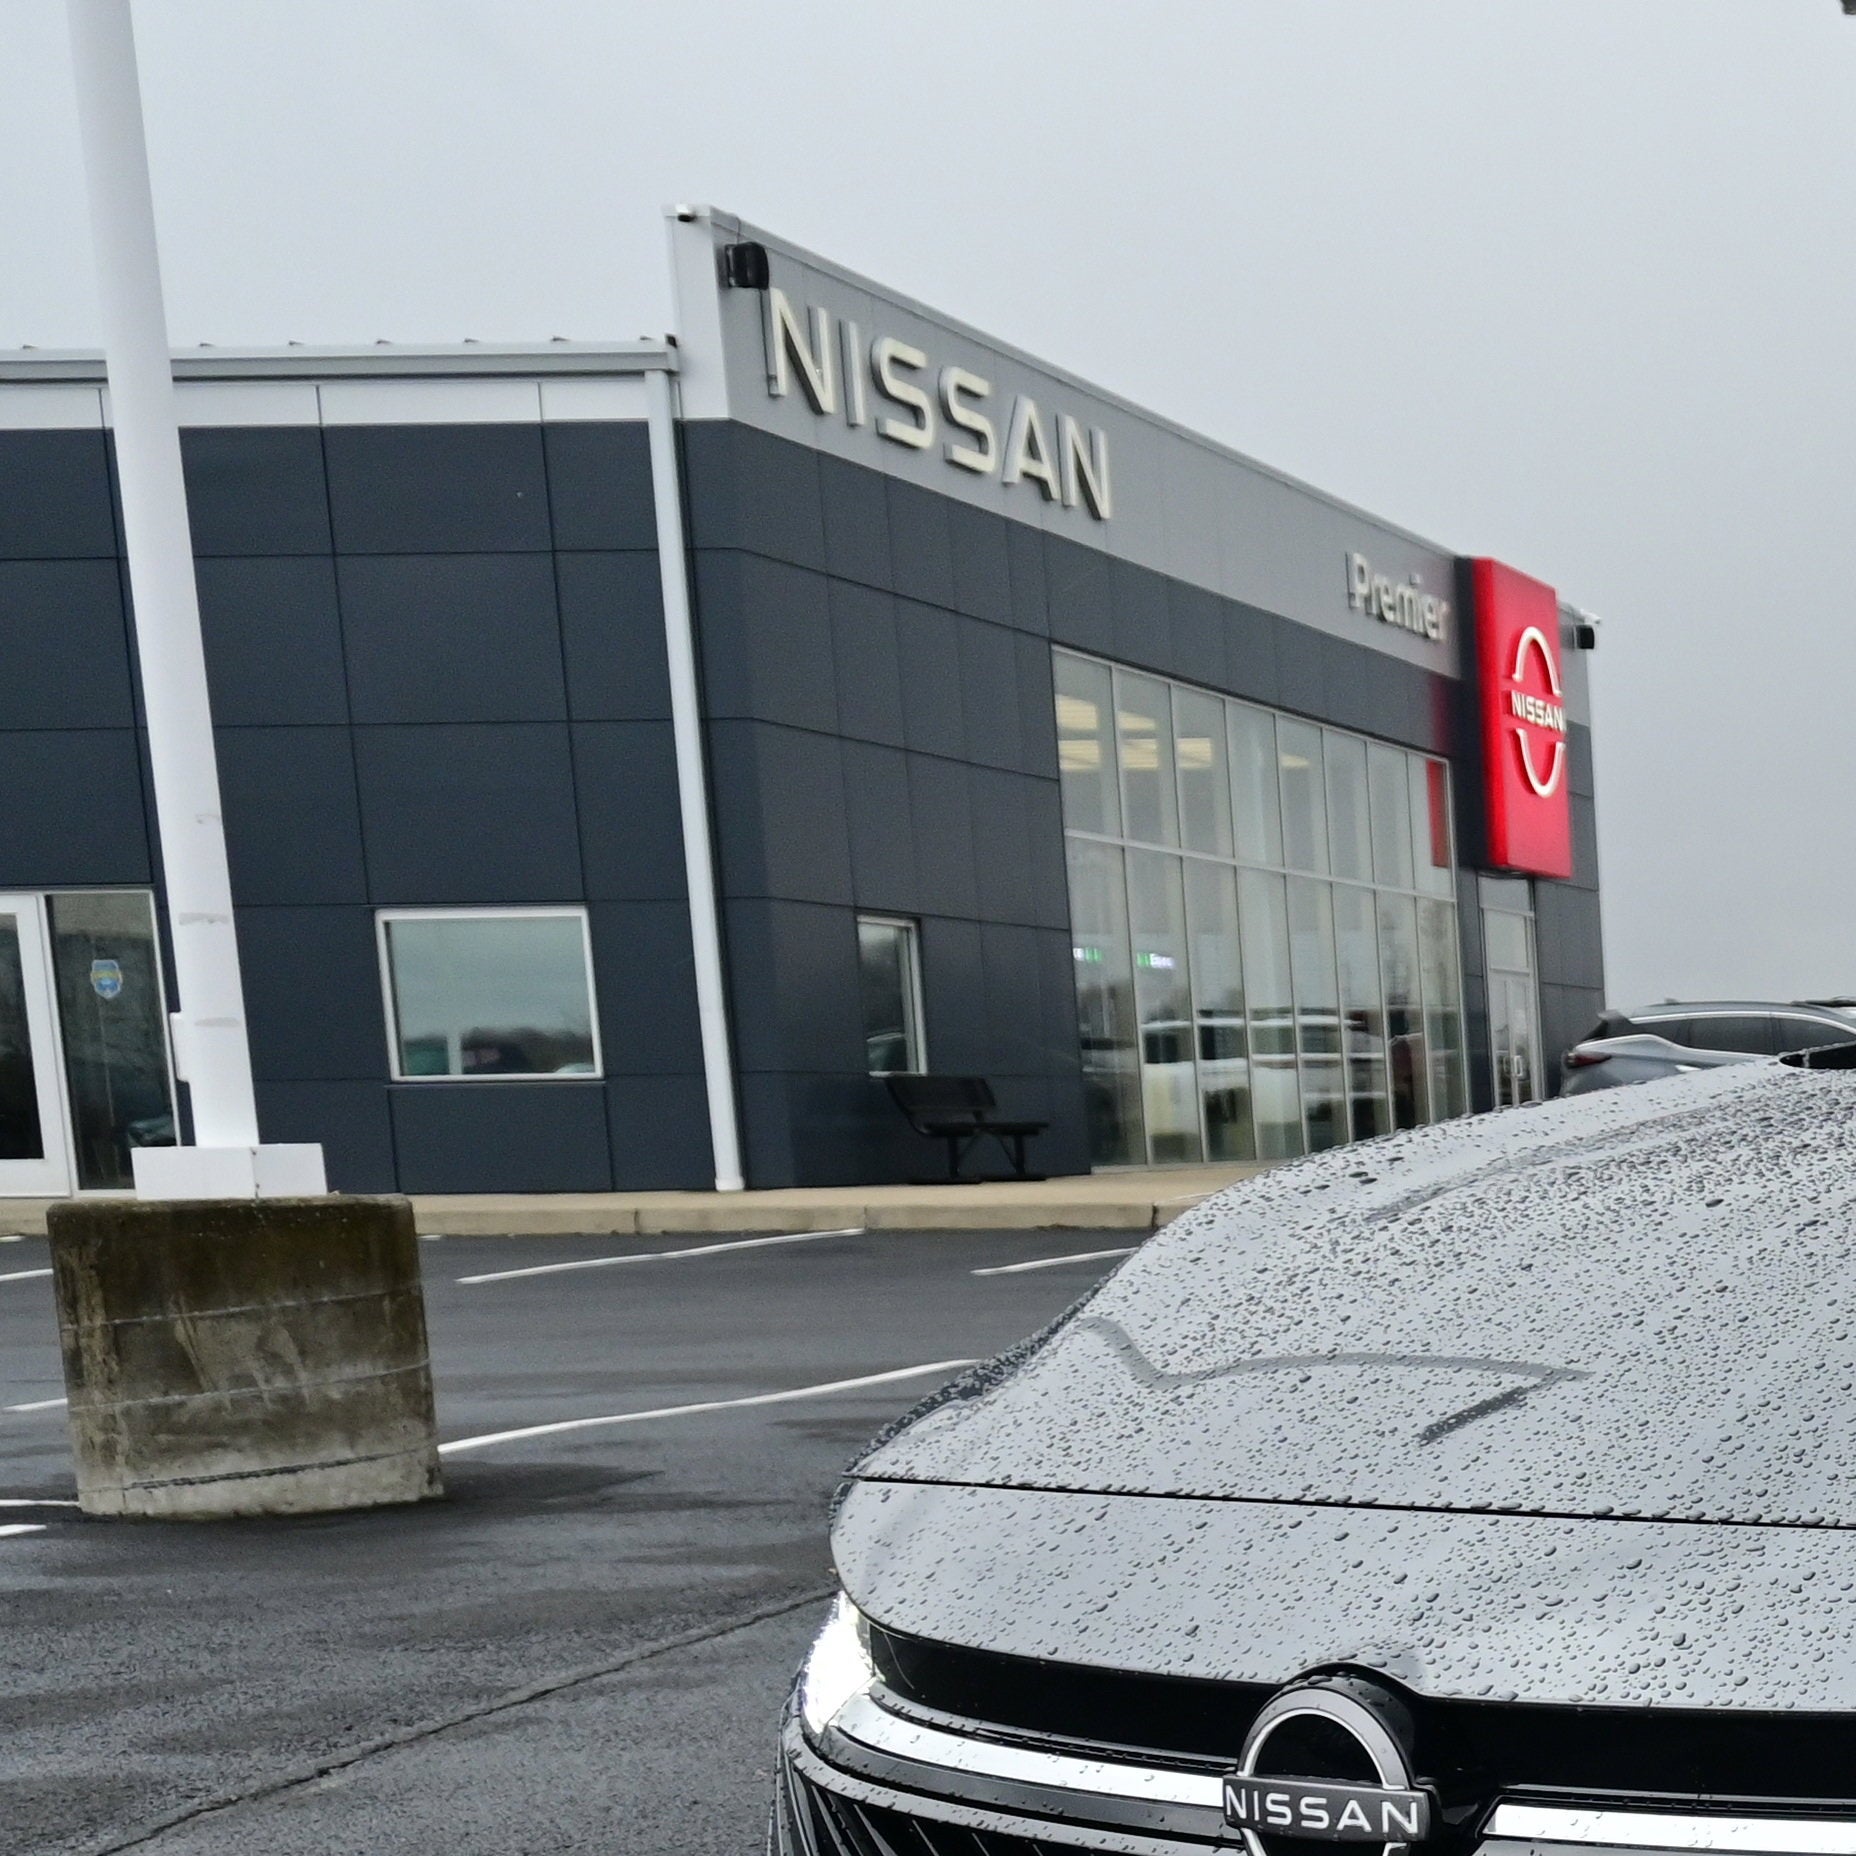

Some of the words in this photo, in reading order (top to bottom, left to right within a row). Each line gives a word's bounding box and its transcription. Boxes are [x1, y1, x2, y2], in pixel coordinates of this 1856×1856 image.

[762, 286, 1112, 521] NISSAN
[1347, 552, 1449, 641] Premier
[1511, 689, 1566, 731] NISSAN
[1225, 1785, 1419, 1834] NISSAN
